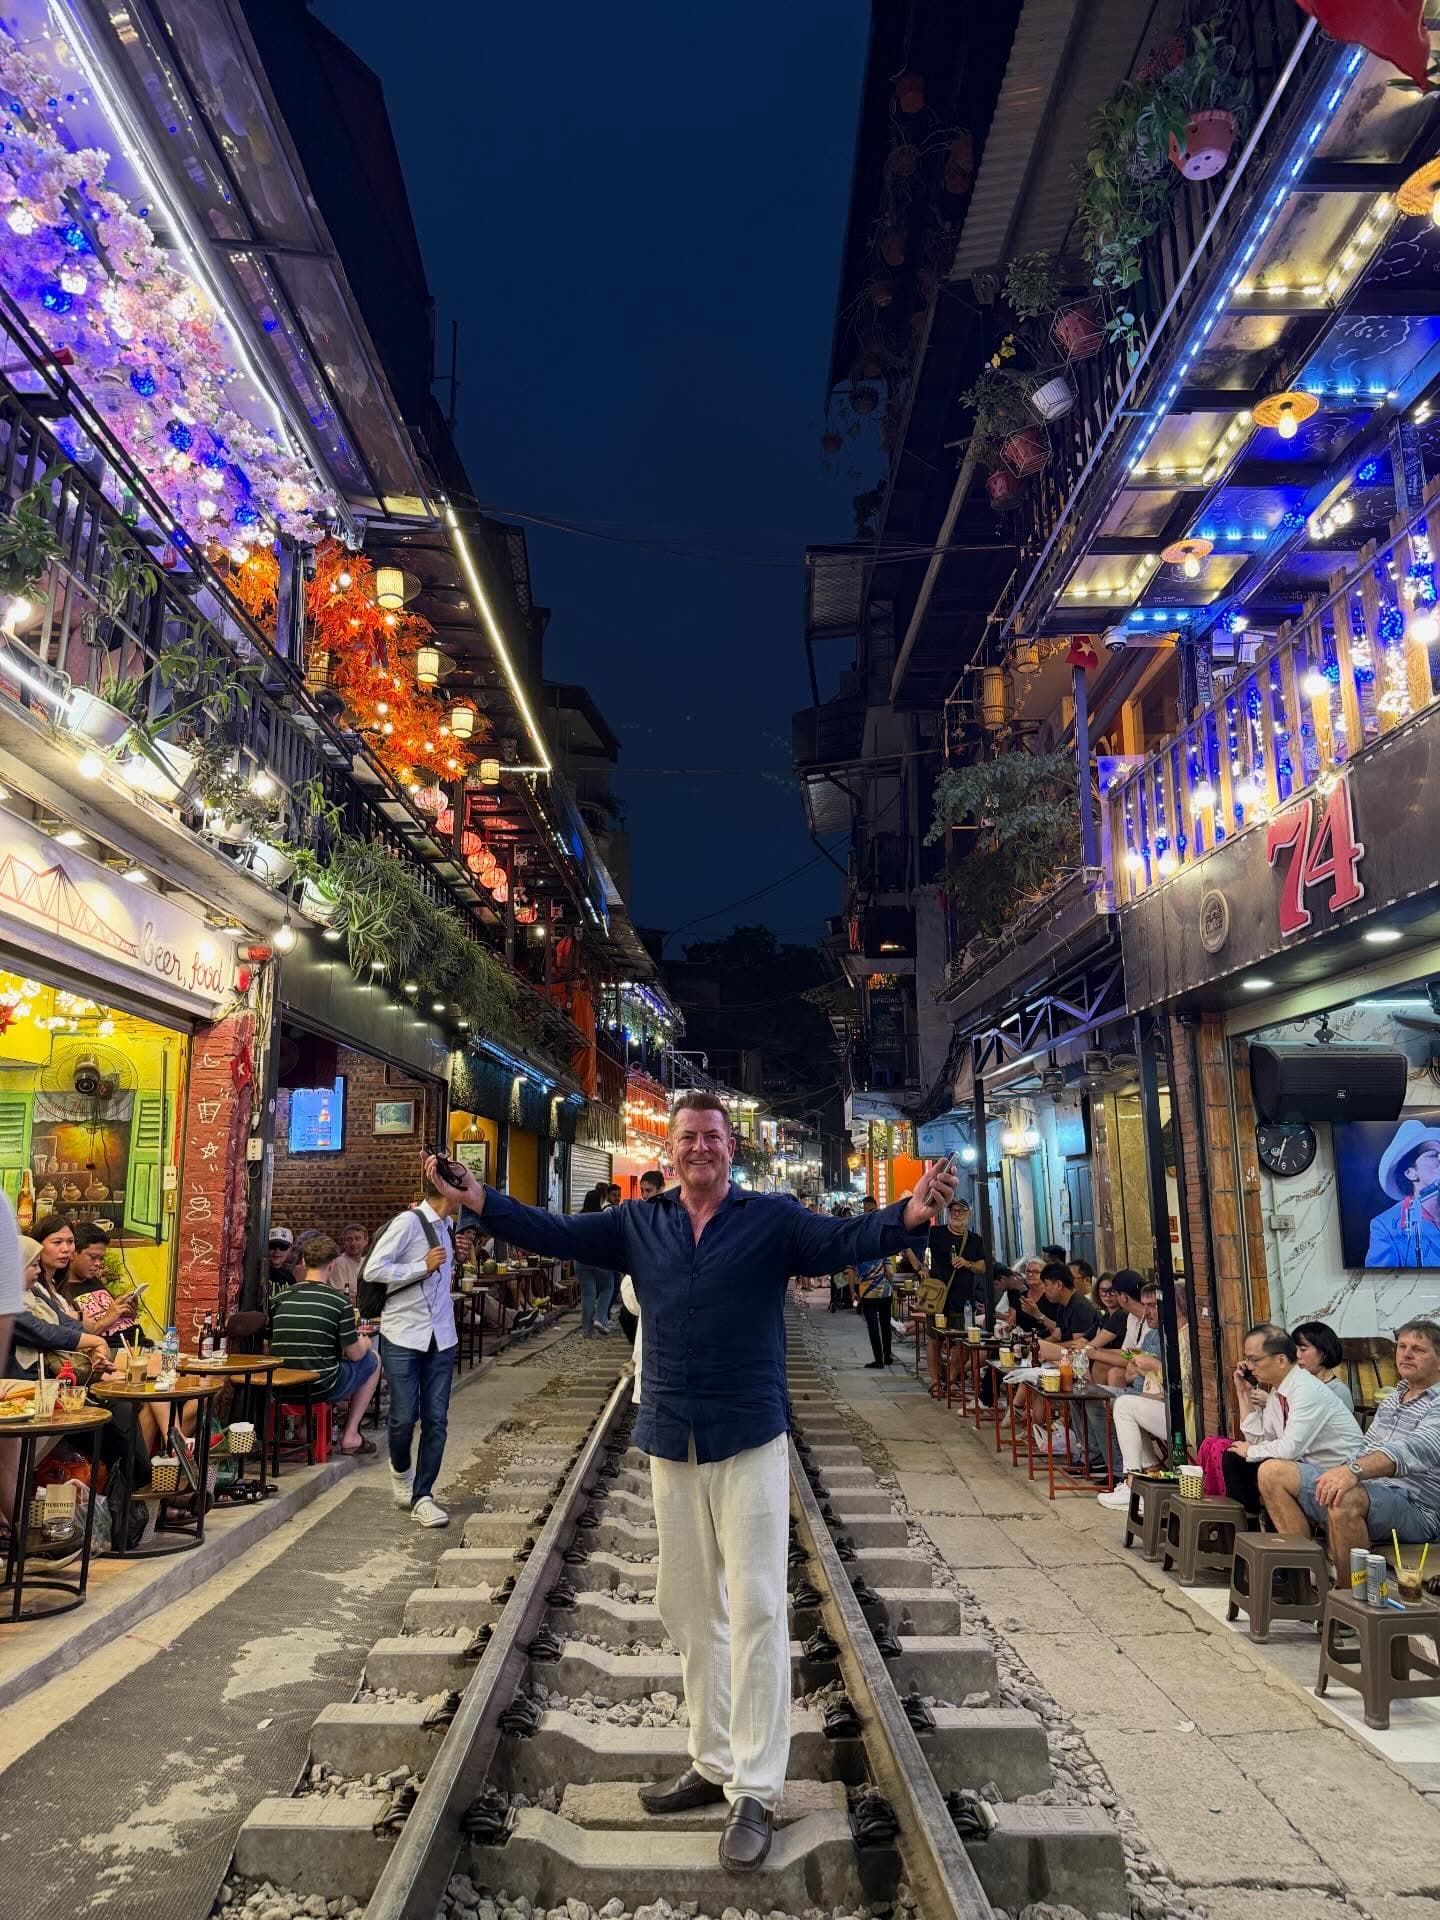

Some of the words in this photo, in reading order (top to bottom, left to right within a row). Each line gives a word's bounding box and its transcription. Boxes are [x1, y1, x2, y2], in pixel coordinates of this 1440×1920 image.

[1266, 773, 1365, 938] 74
[189, 951, 225, 994] food
[1259, 1136, 1266, 1145] 9
[1302, 1140, 1308, 1149] 3
[1281, 1161, 1287, 1170] 6
